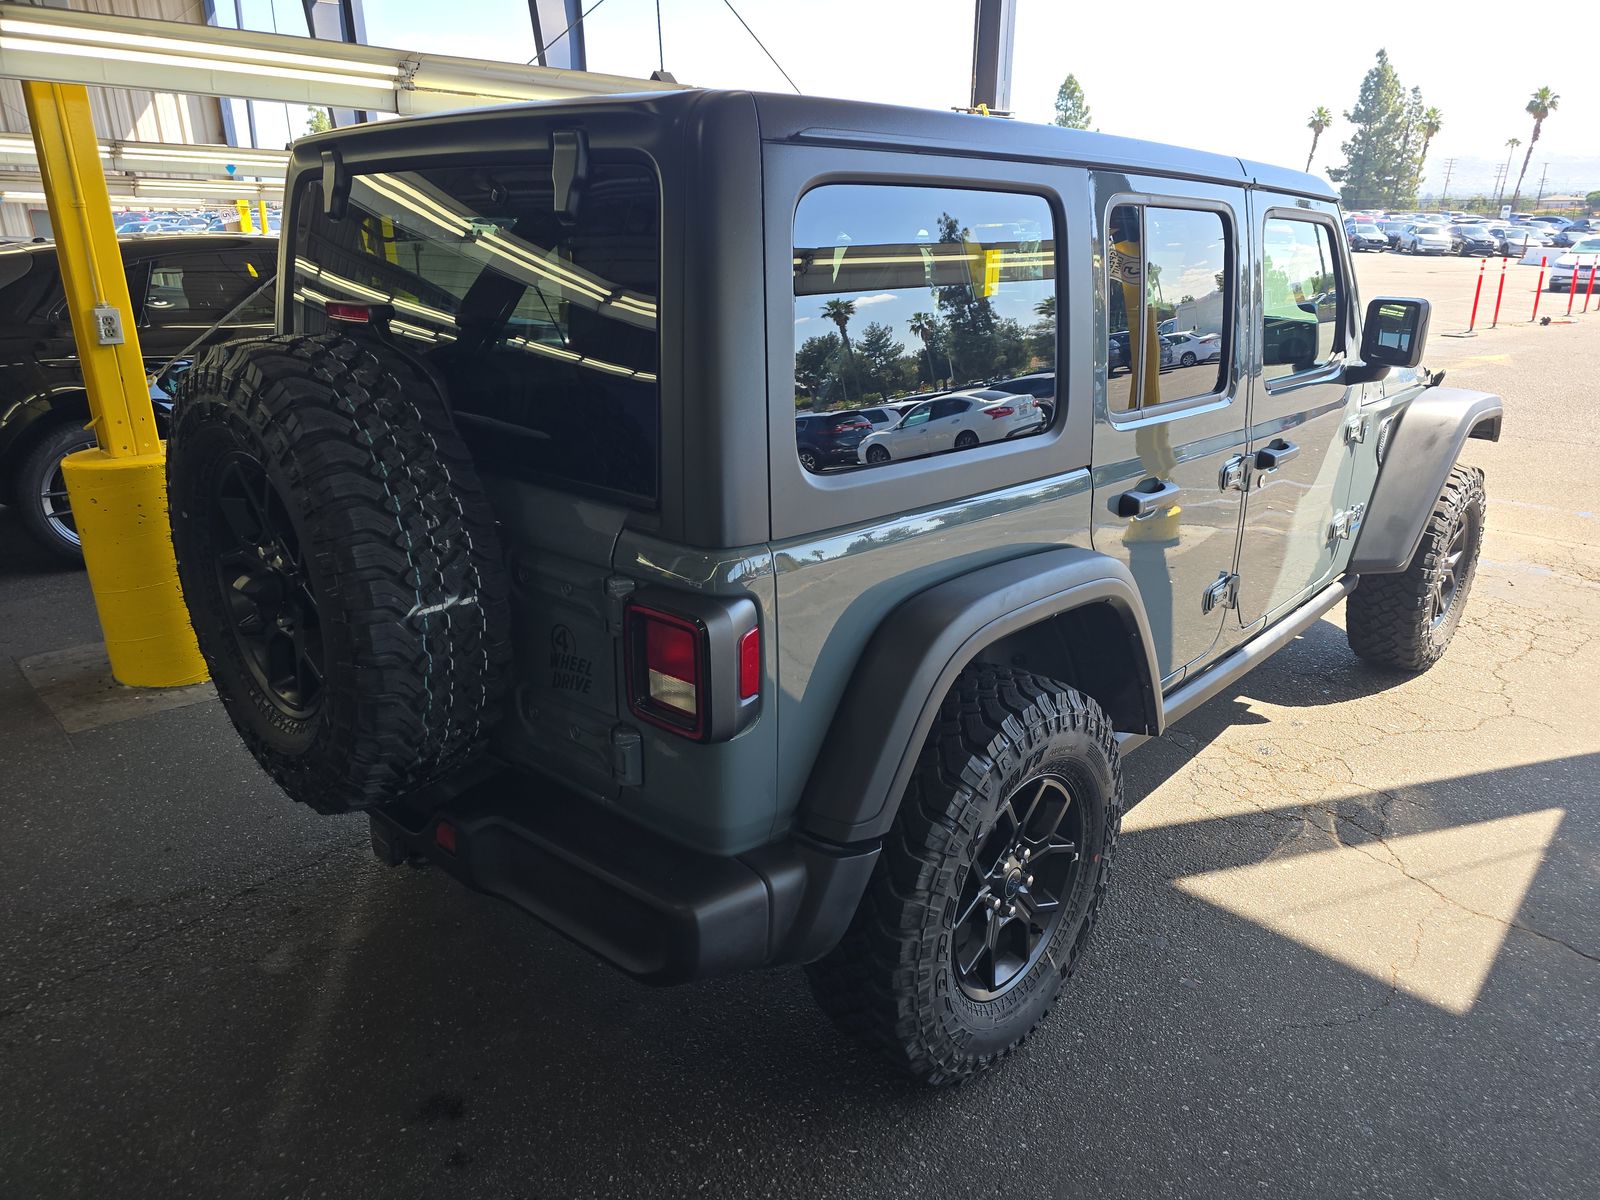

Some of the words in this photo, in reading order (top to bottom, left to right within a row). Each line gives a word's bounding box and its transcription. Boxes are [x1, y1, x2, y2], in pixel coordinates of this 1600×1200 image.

[554, 628, 569, 653] 4
[550, 652, 593, 676] WHEEL
[552, 671, 593, 694] DRIVE
